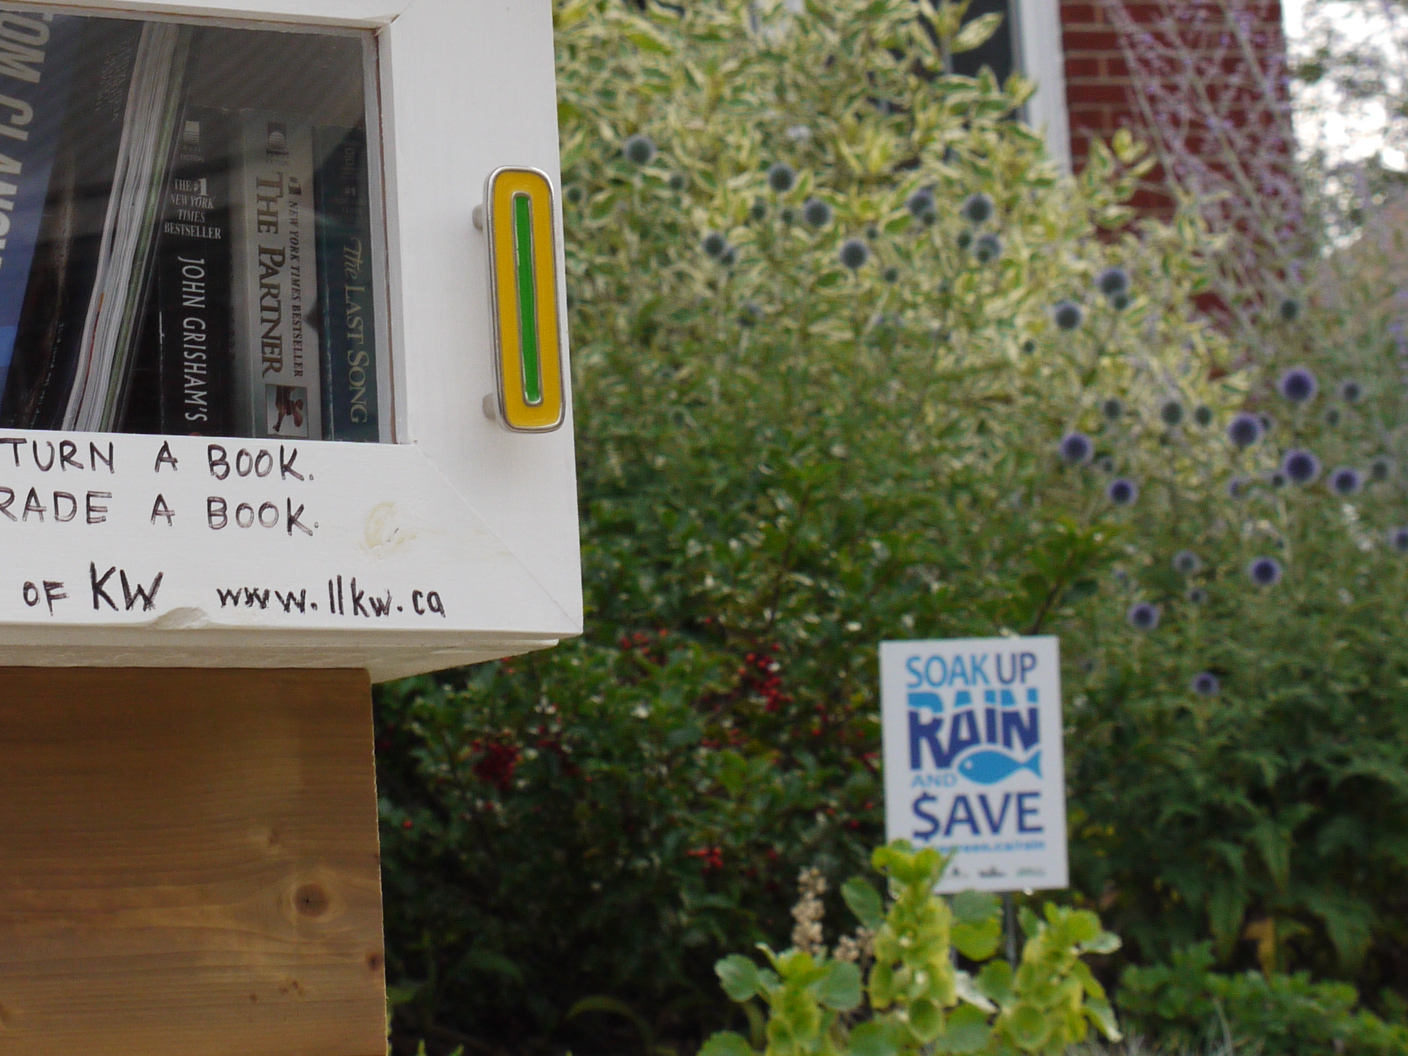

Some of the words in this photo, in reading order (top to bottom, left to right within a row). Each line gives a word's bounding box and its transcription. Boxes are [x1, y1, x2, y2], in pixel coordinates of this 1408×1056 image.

[170, 194, 188, 206] NEW
[191, 195, 215, 209] YORK
[174, 178, 192, 192] THE
[193, 177, 208, 196] #1
[256, 171, 284, 234] THE
[164, 222, 222, 240] BESTSELLER
[178, 209, 205, 223] TIMES
[342, 236, 363, 281] The
[177, 256, 208, 308] JOHN
[258, 244, 287, 378] PARTNER
[344, 284, 366, 346] LAST
[183, 318, 208, 422] GRISHAM'S
[347, 347, 368, 424] SONG
[154, 441, 178, 472] A
[207, 444, 315, 481] BOOK.
[150, 494, 176, 527] A
[207, 496, 320, 536] BOOK.
[22, 581, 69, 615] OF
[91, 562, 164, 612] KW
[216, 576, 447, 618] www.llkw.ca
[905, 653, 989, 689] SOAK
[995, 652, 1037, 685] UP
[907, 687, 1039, 770] RAIN
[911, 773, 957, 788] AND
